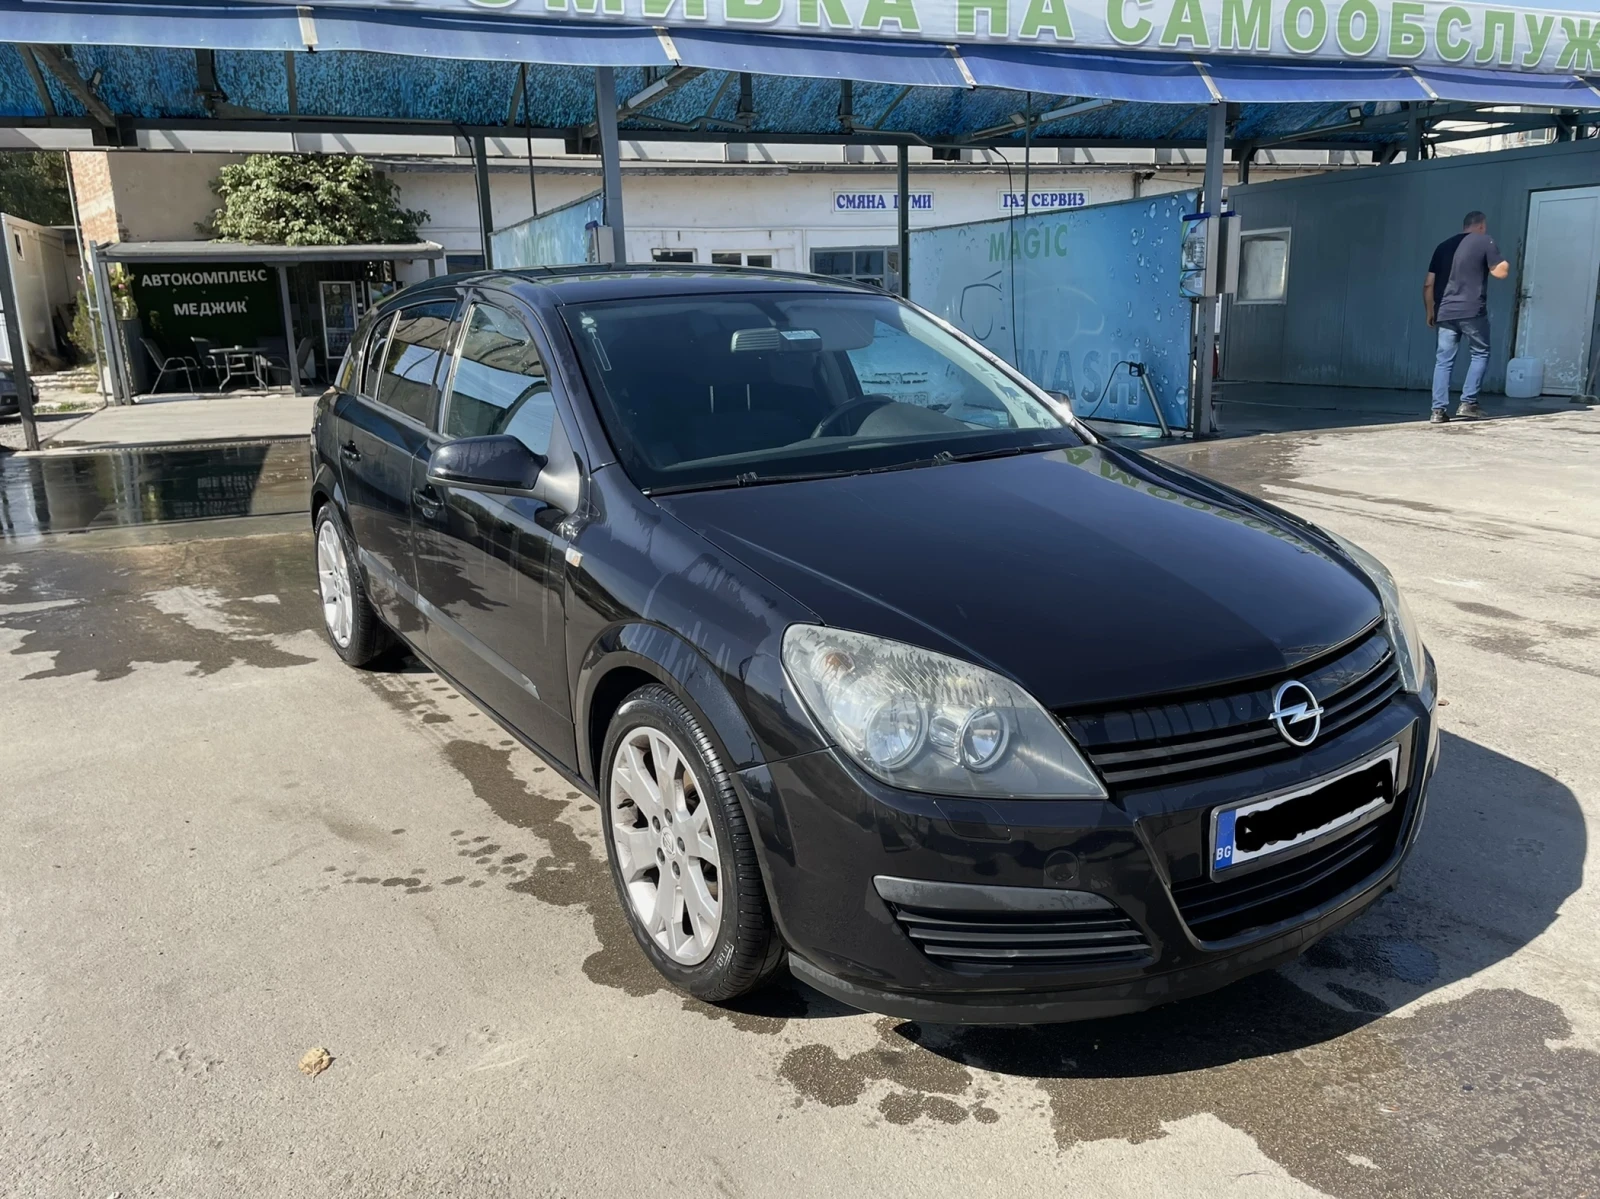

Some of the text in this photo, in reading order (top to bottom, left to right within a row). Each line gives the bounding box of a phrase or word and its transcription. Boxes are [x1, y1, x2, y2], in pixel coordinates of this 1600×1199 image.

[957, 0, 1076, 40] НА
[836, 194, 887, 209] СМЯНА
[1003, 192, 1085, 208] ГАЗ СЕРВИЗ
[988, 224, 1068, 262] MAGIC
[141, 269, 268, 287] АВТОКОМПЛЕКС
[173, 300, 248, 317] МЕДЖИК
[1215, 845, 1232, 861] BG
